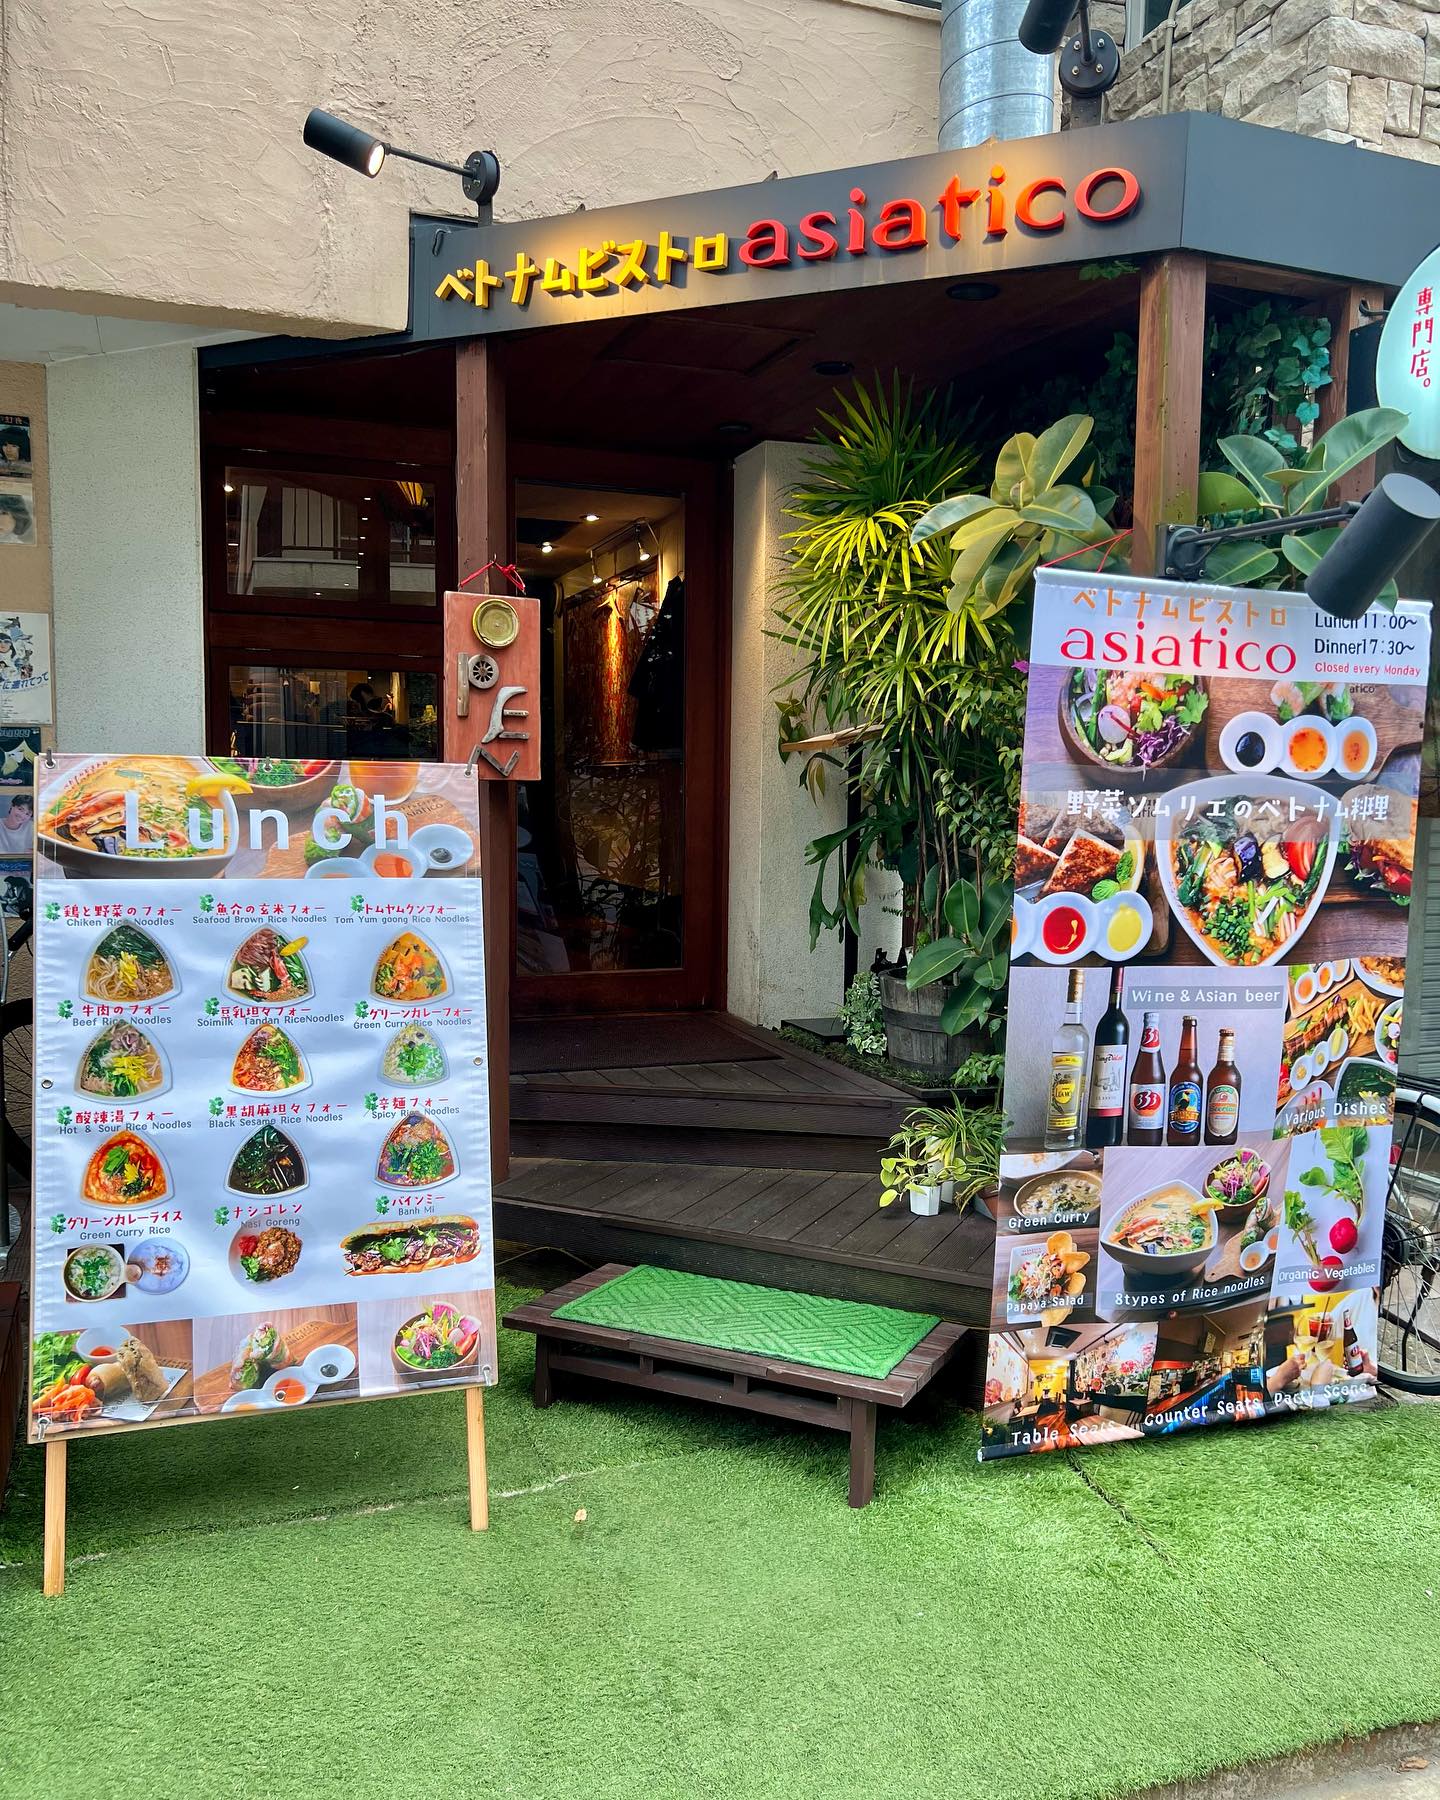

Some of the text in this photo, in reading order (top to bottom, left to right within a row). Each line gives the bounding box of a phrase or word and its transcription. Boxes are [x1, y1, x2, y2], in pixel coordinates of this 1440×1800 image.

[738, 164, 1142, 269] asiatico
[434, 230, 729, 309] ベトナムビストロ
[1410, 286, 1434, 388] 専門店。
[1073, 588, 1286, 628] ベトナムビストロ
[1060, 620, 1296, 674] asiatico
[1314, 662, 1421, 677] Closed every Monday
[1066, 789, 1390, 822] 野菜ソムリエのベトナム料理
[126, 791, 409, 850] Lunch
[63, 904, 183, 918] 鶏と野菜のフォー
[216, 902, 325, 916] 魚介の玄米フォー
[365, 903, 456, 915] トムヤムクンフォー
[66, 918, 102, 927] Chiken
[134, 917, 174, 926] Noodles
[193, 914, 327, 924] Seafood Brown Rice Noodles
[335, 916, 354, 924] Tom
[358, 916, 378, 924] Yum
[412, 915, 431, 923] Rice
[435, 914, 470, 923] Noodles
[1131, 988, 1280, 1003] Wine & Asian beer
[82, 1004, 170, 1017] 牛肉のフォー
[369, 1007, 473, 1020] グリーンカレーフォー
[72, 1017, 97, 1027] Beef
[130, 1016, 171, 1025] Noodles
[197, 1017, 234, 1027] Soimilk
[353, 1017, 472, 1029] Green Curry Rice Noodles
[379, 1096, 449, 1110] 辛麺フォー
[209, 1113, 343, 1128] Black Sesame Rice Noodles
[372, 1110, 396, 1120] Spicy
[424, 1106, 460, 1116] Noodles
[1285, 1101, 1387, 1126] Various Dishes
[59, 1120, 192, 1135] Hot & Sour Rice Noodles
[392, 1194, 447, 1206] バインミー
[233, 1203, 303, 1219] ナシゴレン
[398, 1205, 435, 1216] Banh Mi
[67, 1210, 183, 1230] グリーンカレーライス
[241, 1218, 300, 1229] Nasi Goreng
[1008, 1211, 1090, 1230] Green Curry
[80, 1226, 171, 1240] Green Curry Rice
[1278, 1262, 1376, 1283] Organic Vegetables
[1172, 1289, 1187, 1303] of
[1192, 1285, 1218, 1300] Rice
[1223, 1274, 1265, 1294] noodles
[1052, 1294, 1084, 1308] Salad
[1323, 1384, 1367, 1399] Scene
[1144, 1397, 1259, 1427] Counter Seats
[1011, 1420, 1115, 1446] Table Seats
